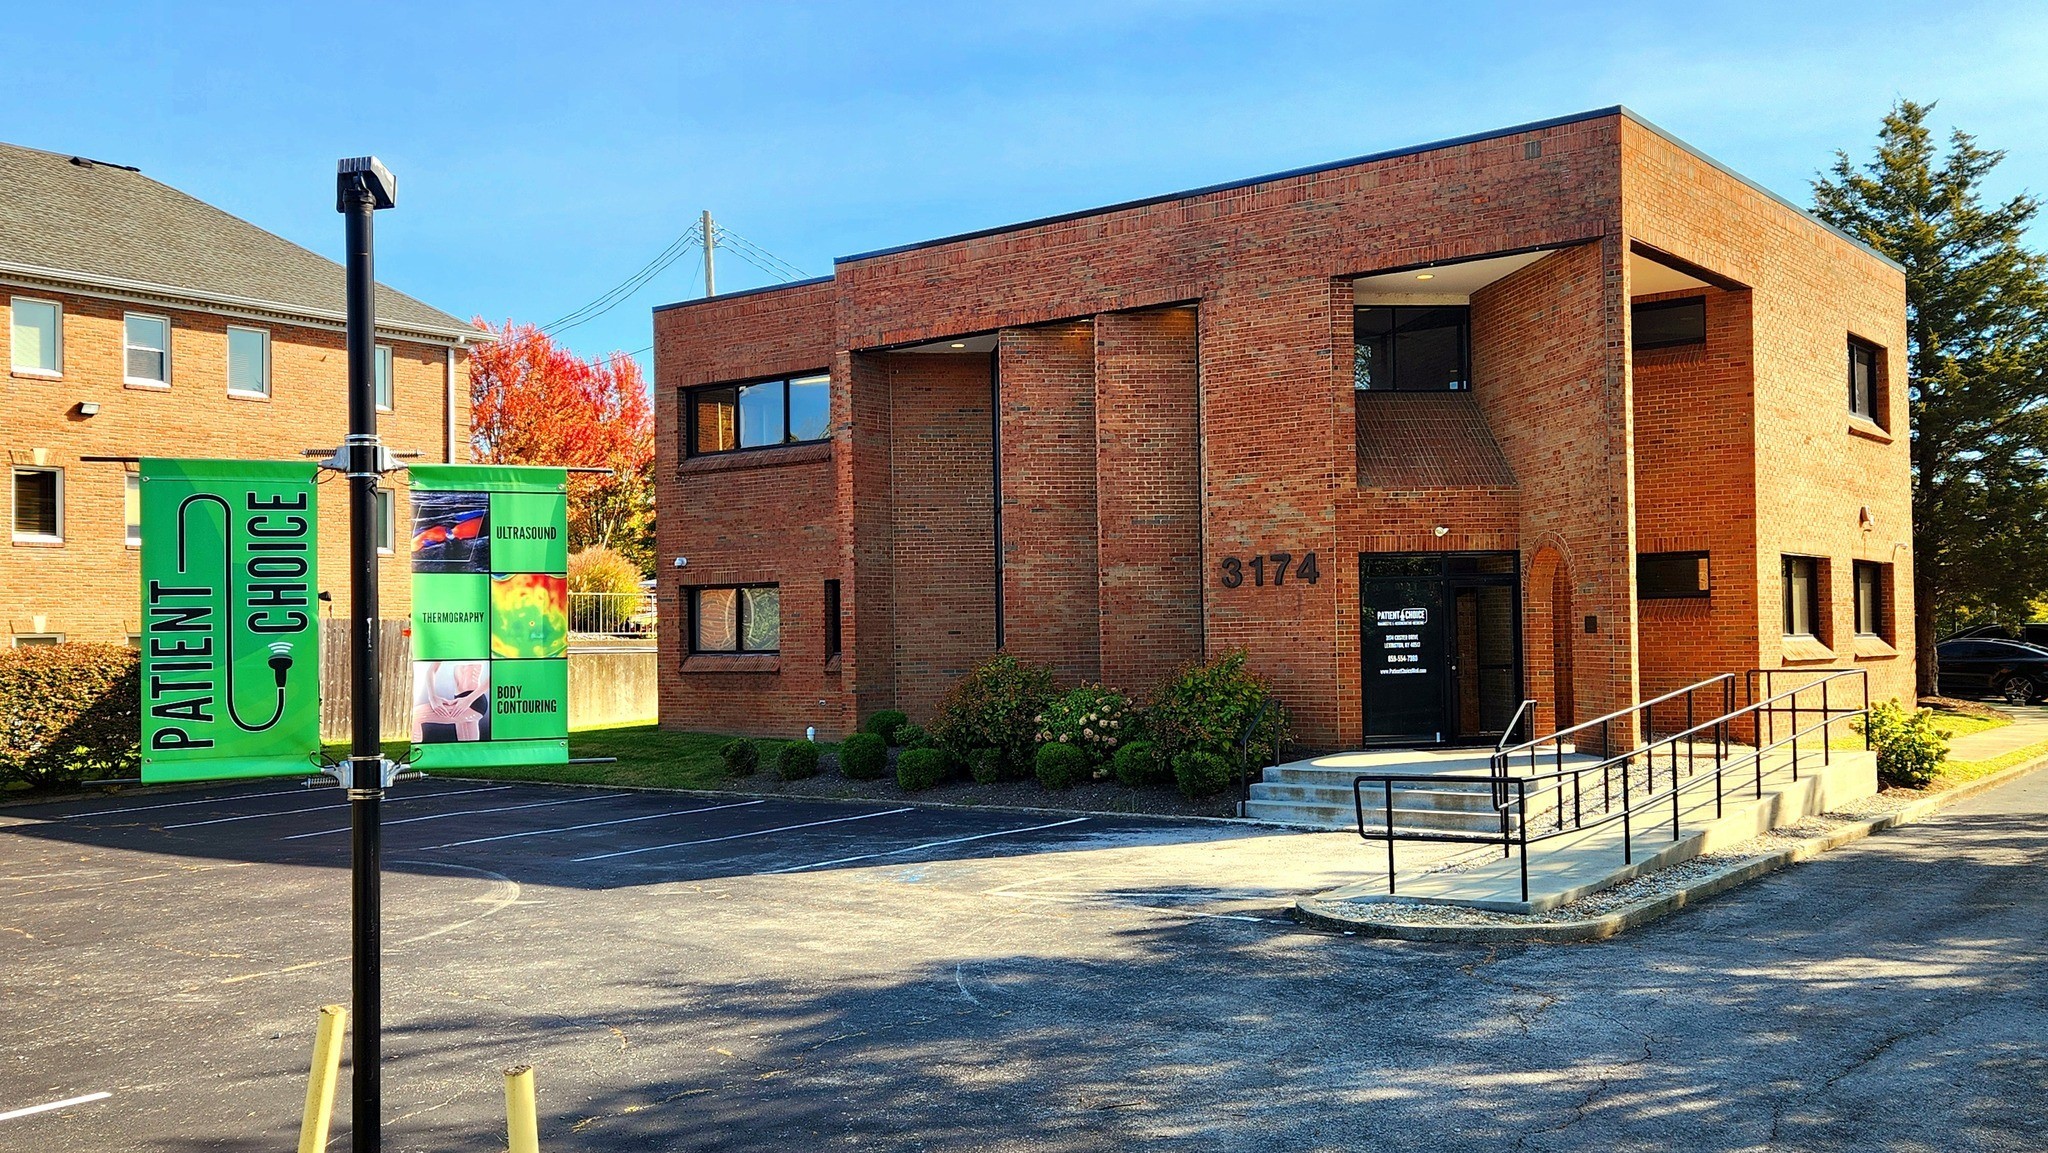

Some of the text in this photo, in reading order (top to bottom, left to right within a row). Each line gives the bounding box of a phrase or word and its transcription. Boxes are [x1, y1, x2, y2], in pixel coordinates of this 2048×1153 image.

[496, 526, 557, 540] ULTRASOUND
[246, 491, 309, 634] CHOICE
[1221, 551, 1320, 588] 3174
[422, 612, 484, 624] THERMOGRAPHY
[1377, 611, 1425, 620] PATIENT CHOICE
[149, 580, 214, 751] PATIENT
[497, 686, 523, 699] BODY
[497, 700, 557, 714] CONTOURING
